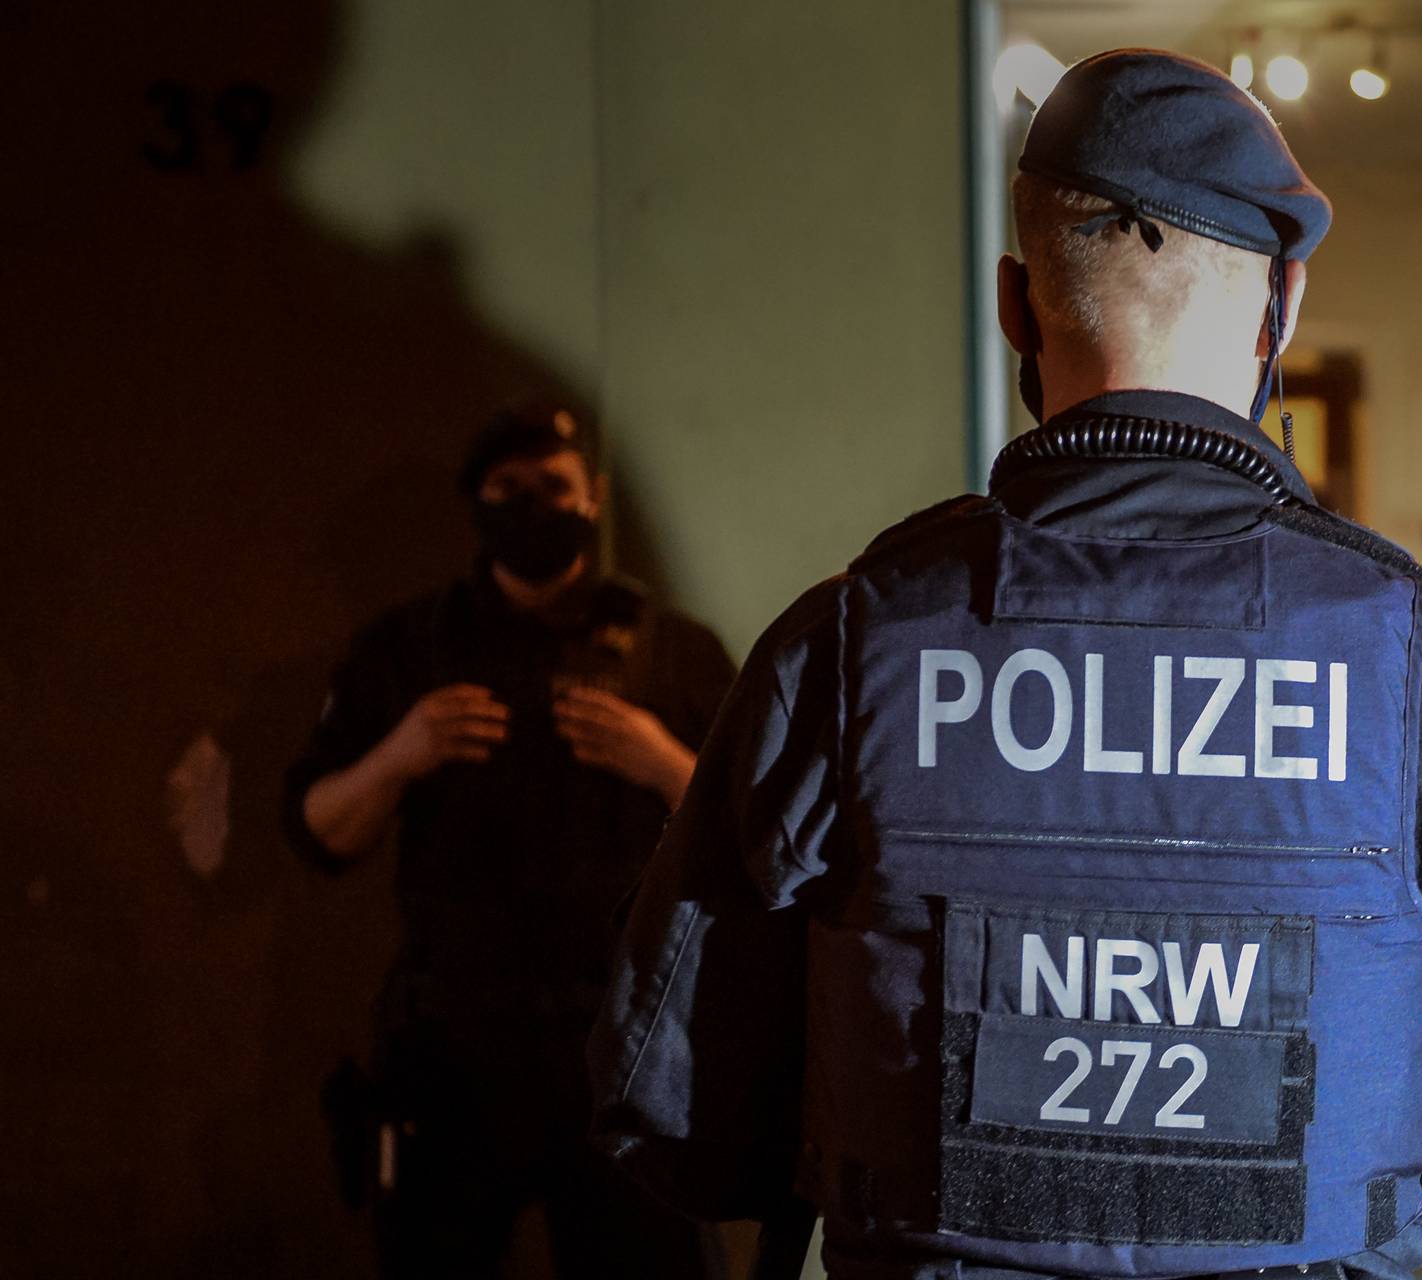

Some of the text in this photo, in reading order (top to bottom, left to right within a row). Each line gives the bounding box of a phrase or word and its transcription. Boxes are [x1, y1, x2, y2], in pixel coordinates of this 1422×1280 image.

[141, 79, 273, 172] 39
[918, 648, 1347, 782] POLIZEI
[1021, 934, 1260, 1027] NRW
[1040, 1037, 1208, 1129] 272
